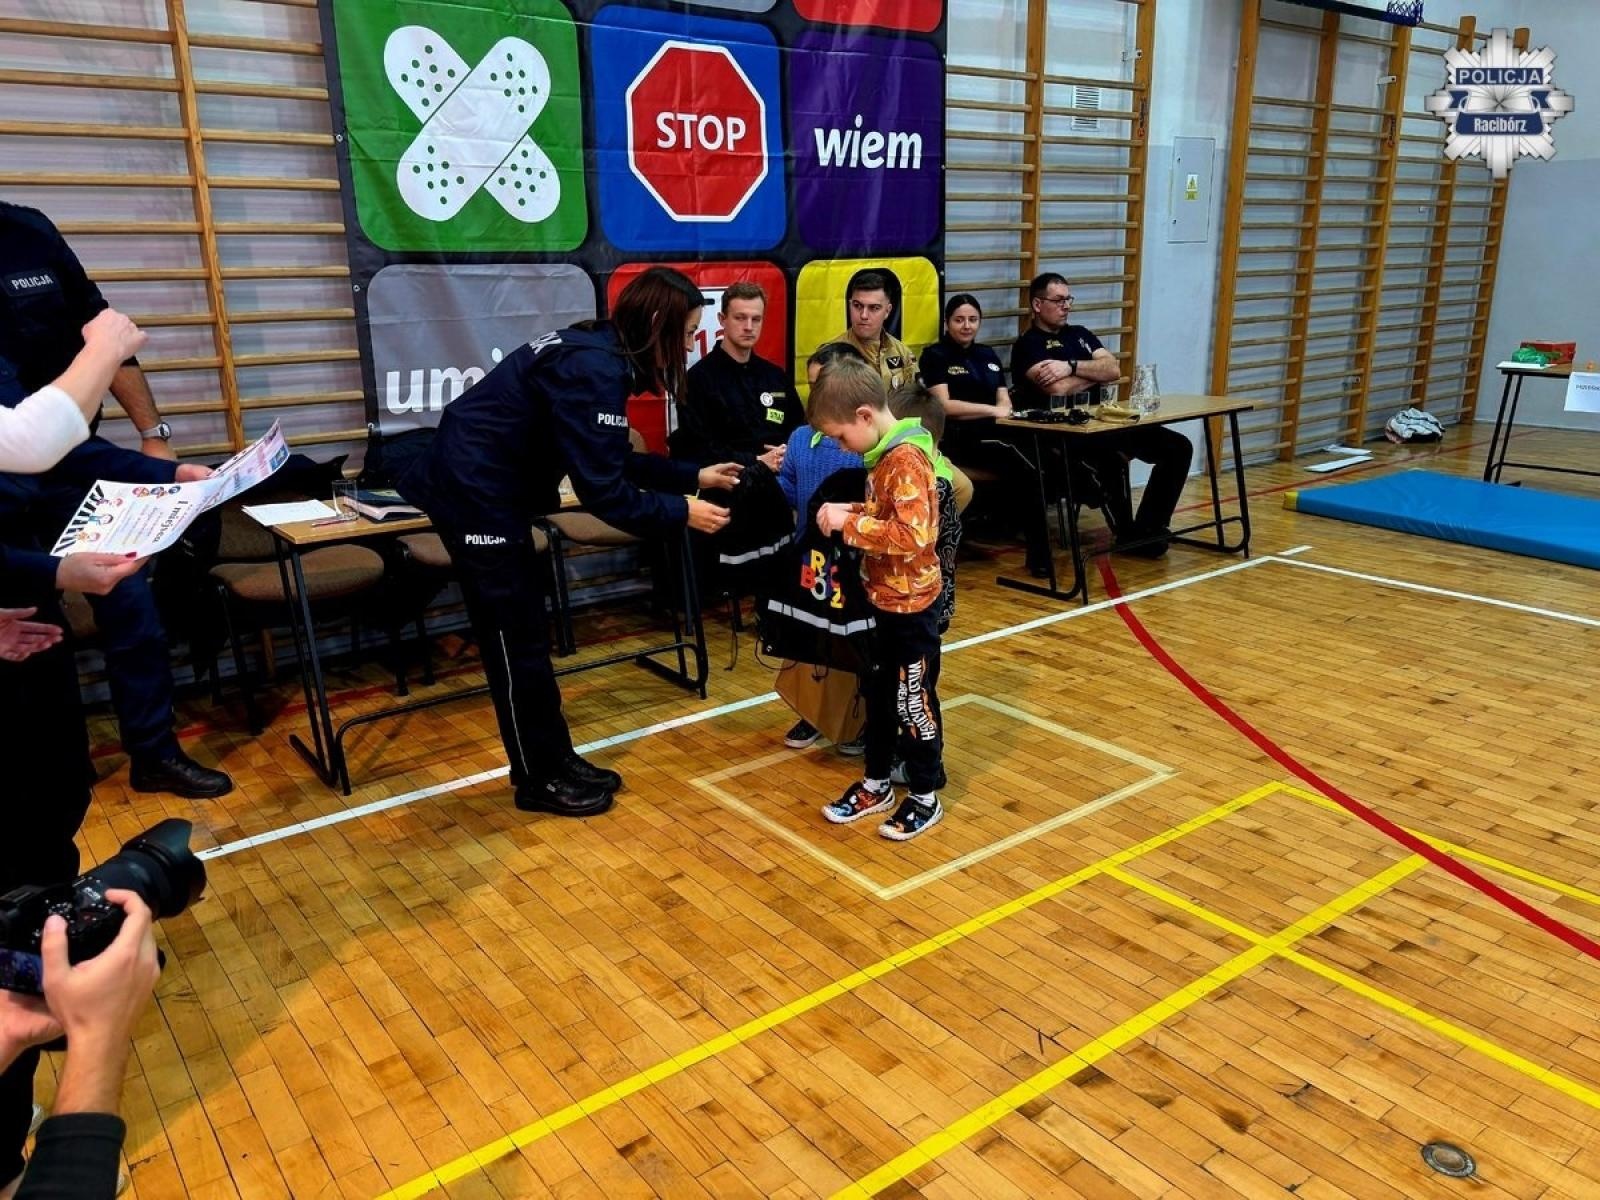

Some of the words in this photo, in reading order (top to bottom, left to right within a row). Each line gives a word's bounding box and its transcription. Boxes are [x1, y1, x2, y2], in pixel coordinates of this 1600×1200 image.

[656, 111, 746, 152] STOP
[814, 114, 923, 170] wiem
[11, 274, 54, 290] POLICJA
